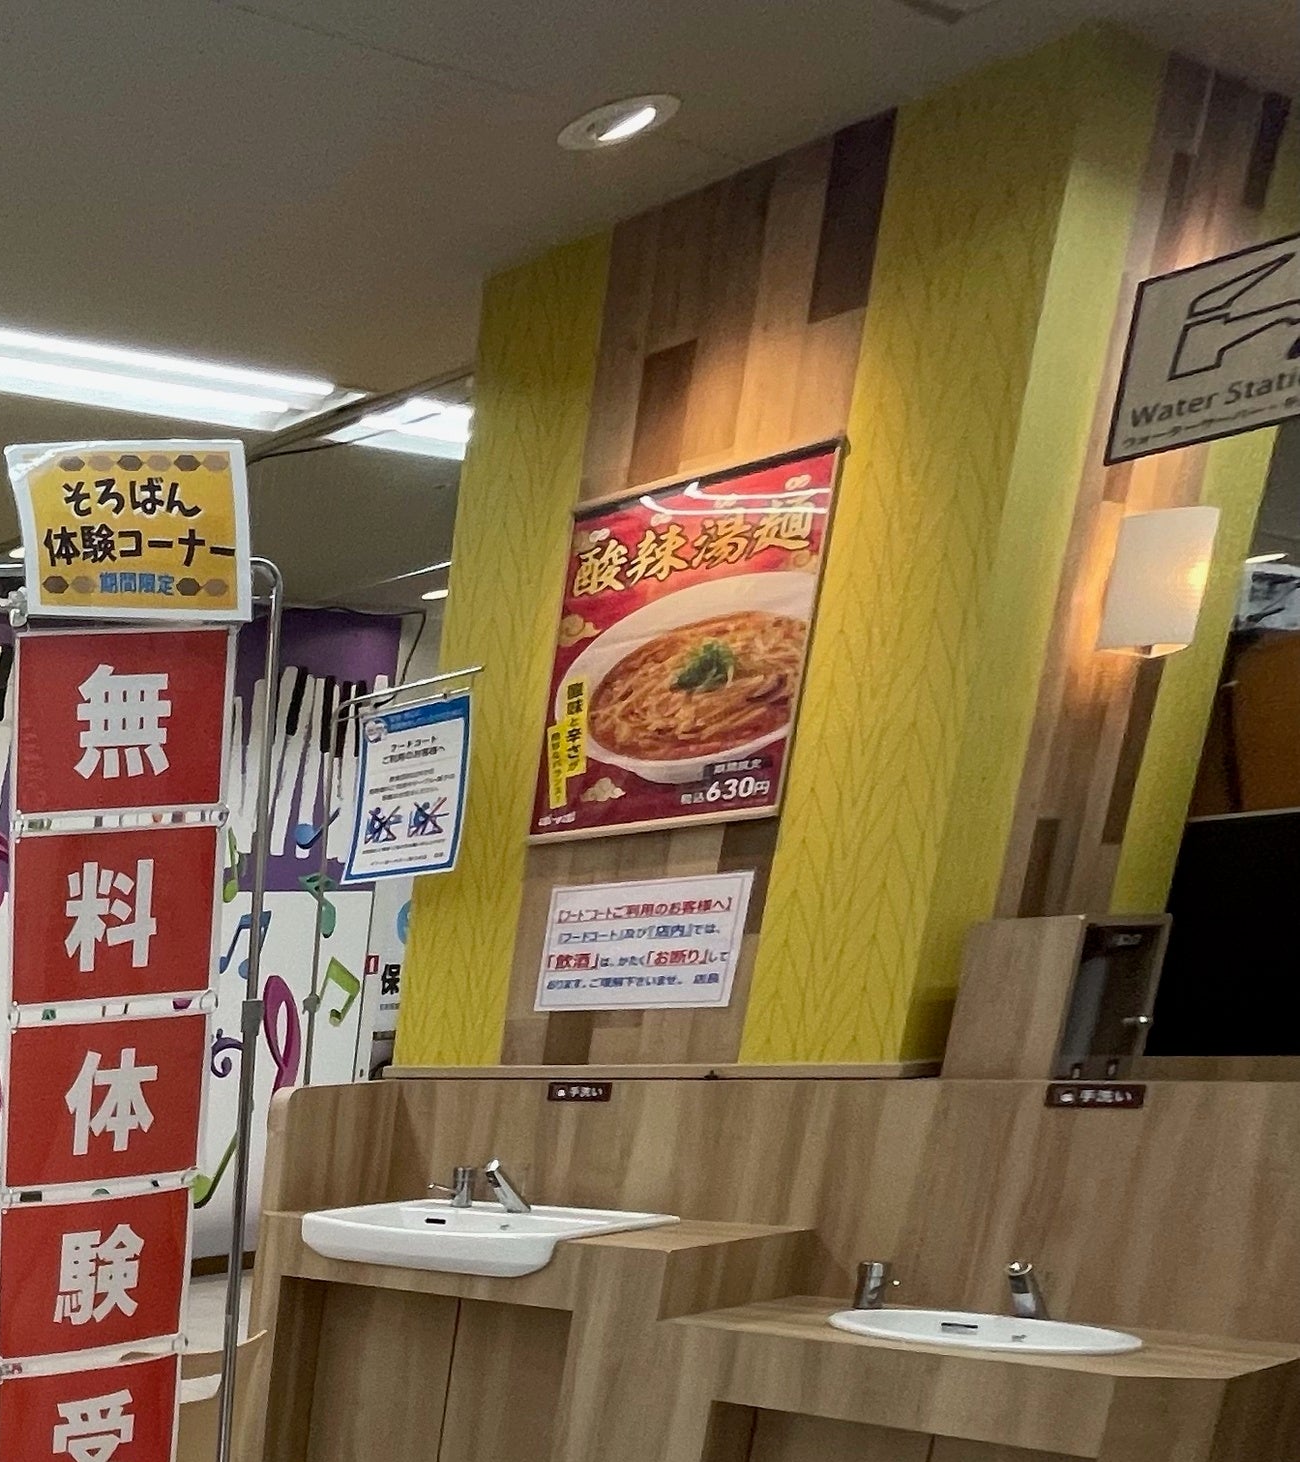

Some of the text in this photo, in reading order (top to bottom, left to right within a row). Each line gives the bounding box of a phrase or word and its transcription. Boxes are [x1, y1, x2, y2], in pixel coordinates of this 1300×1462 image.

[1130, 391, 1219, 427] Water
[1224, 370, 1300, 405] Stati
[62, 476, 202, 517] そろばん
[43, 524, 236, 567] 体験コーナー
[99, 572, 175, 595] 期間限定
